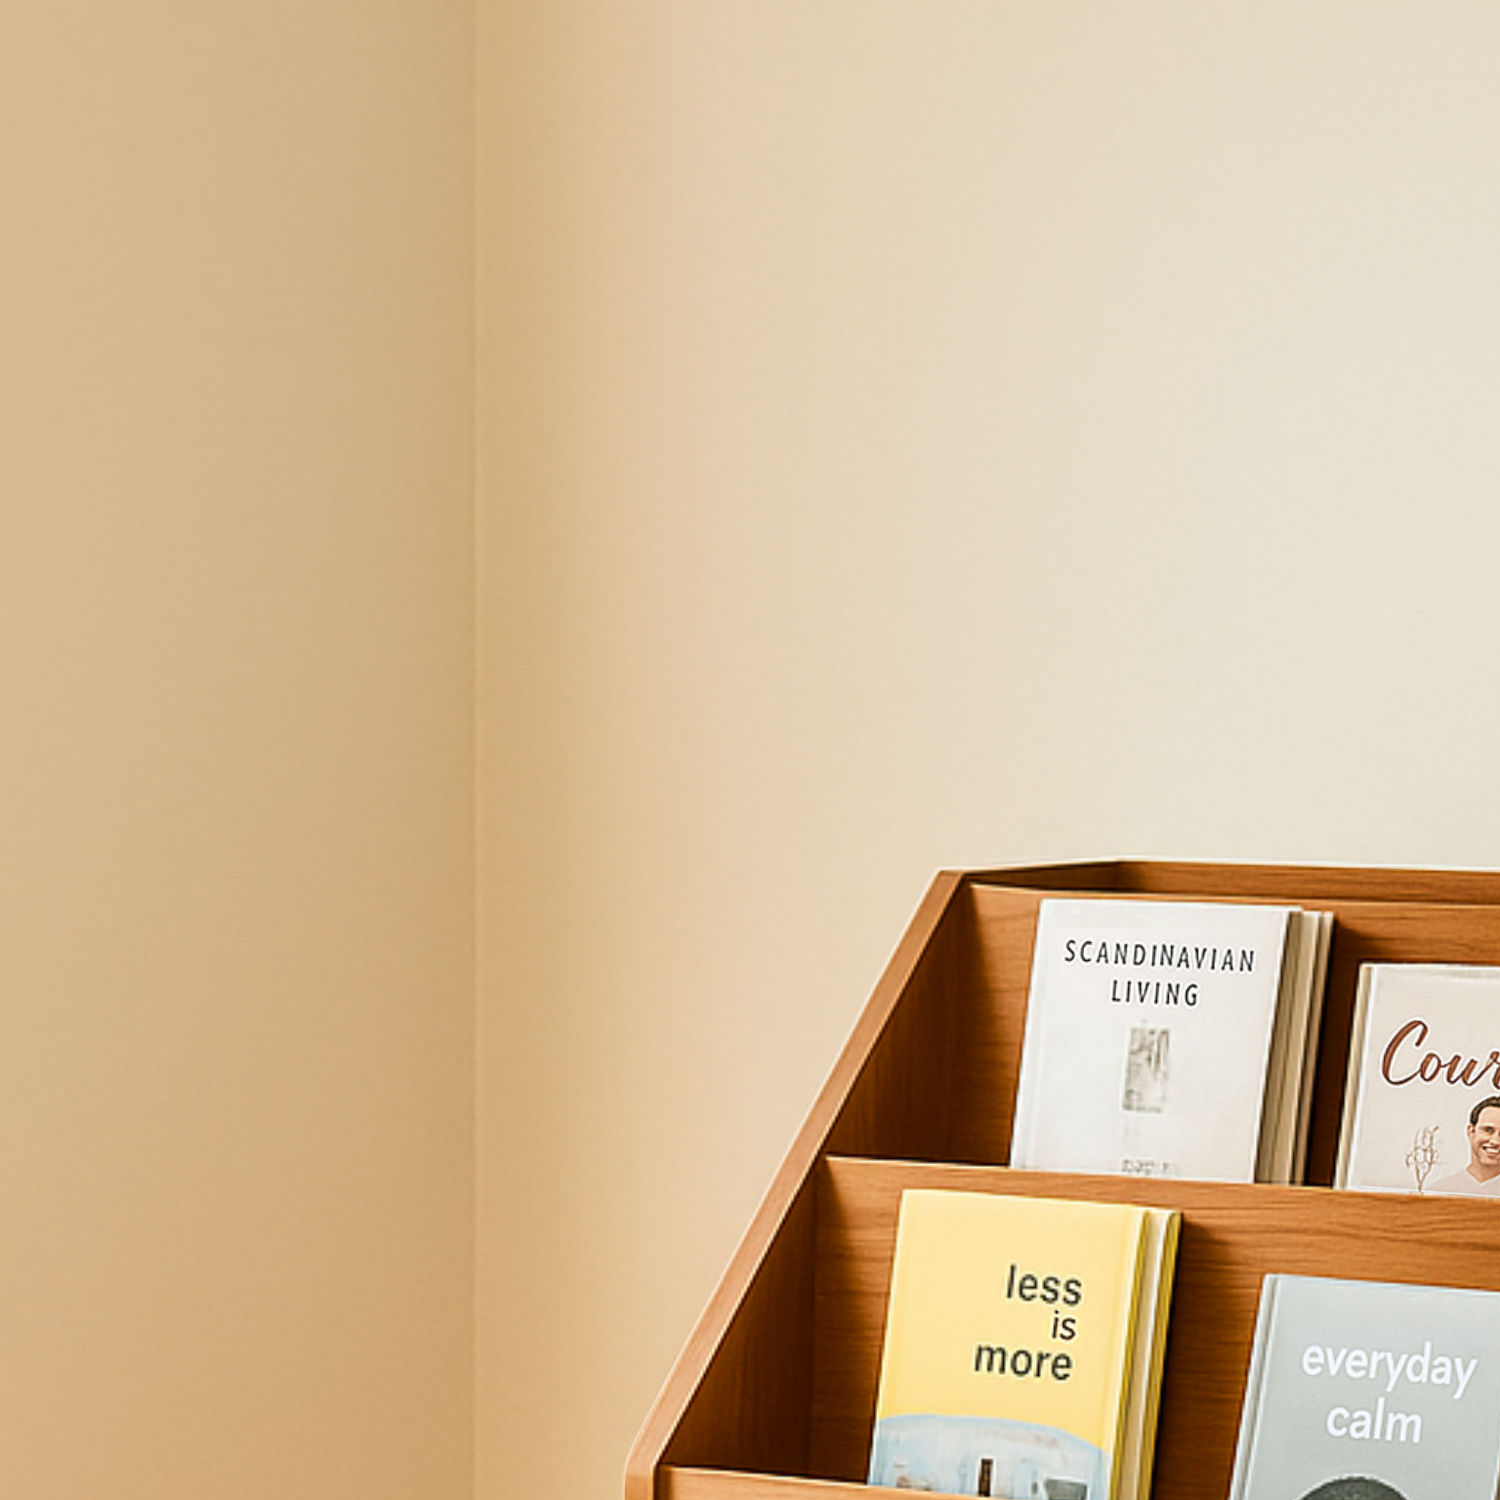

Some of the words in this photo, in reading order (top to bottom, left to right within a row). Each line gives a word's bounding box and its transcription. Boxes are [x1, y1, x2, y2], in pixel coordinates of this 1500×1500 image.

[1065, 939, 1255, 972] SCANDINAVIAN
[1111, 980, 1199, 1007] LIVING
[1006, 1264, 1083, 1306] less
[1051, 1310, 1077, 1341] is
[974, 1344, 1073, 1381] more
[1302, 1341, 1478, 1400] everyday
[1326, 1397, 1423, 1443] calm
